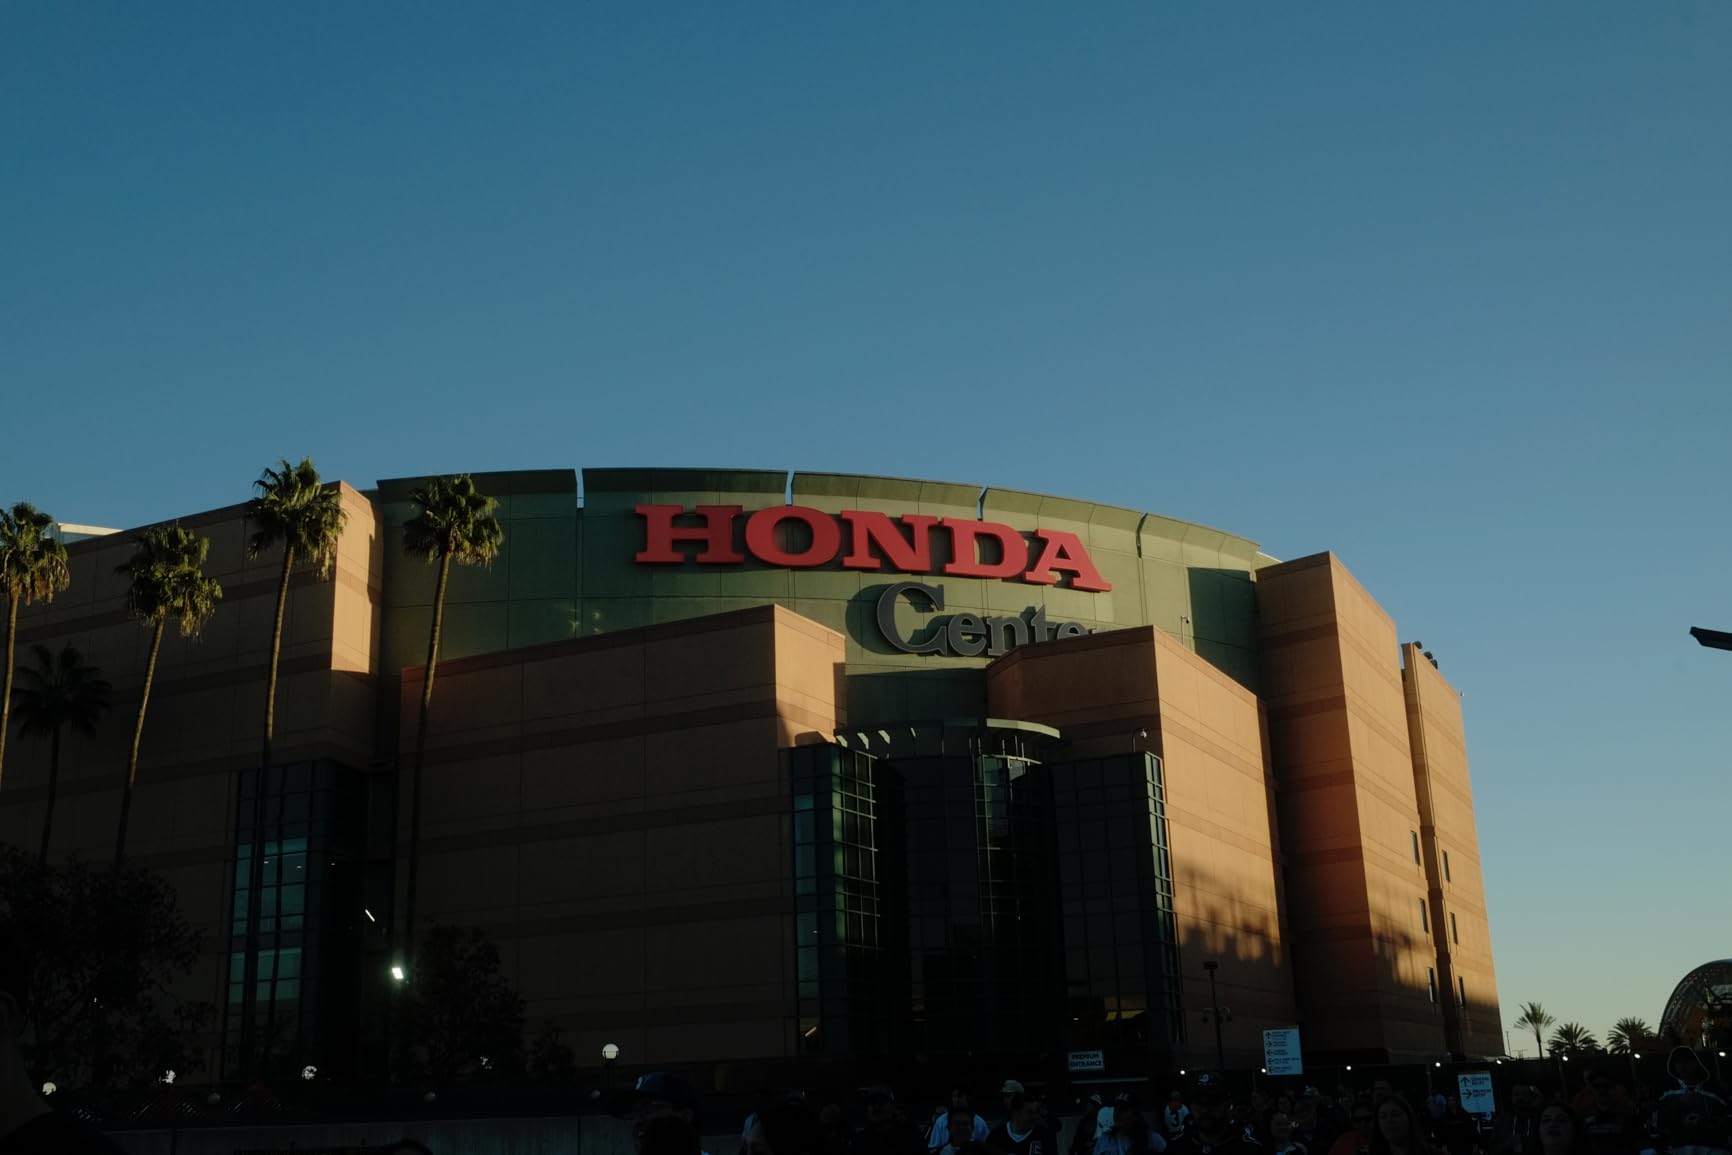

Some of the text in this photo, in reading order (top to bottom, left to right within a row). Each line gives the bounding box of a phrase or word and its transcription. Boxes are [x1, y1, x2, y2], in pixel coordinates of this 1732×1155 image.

[634, 504, 1112, 592] HONDA
[876, 581, 1092, 657] Cente
[1071, 1053, 1099, 1061] PREMIUM
